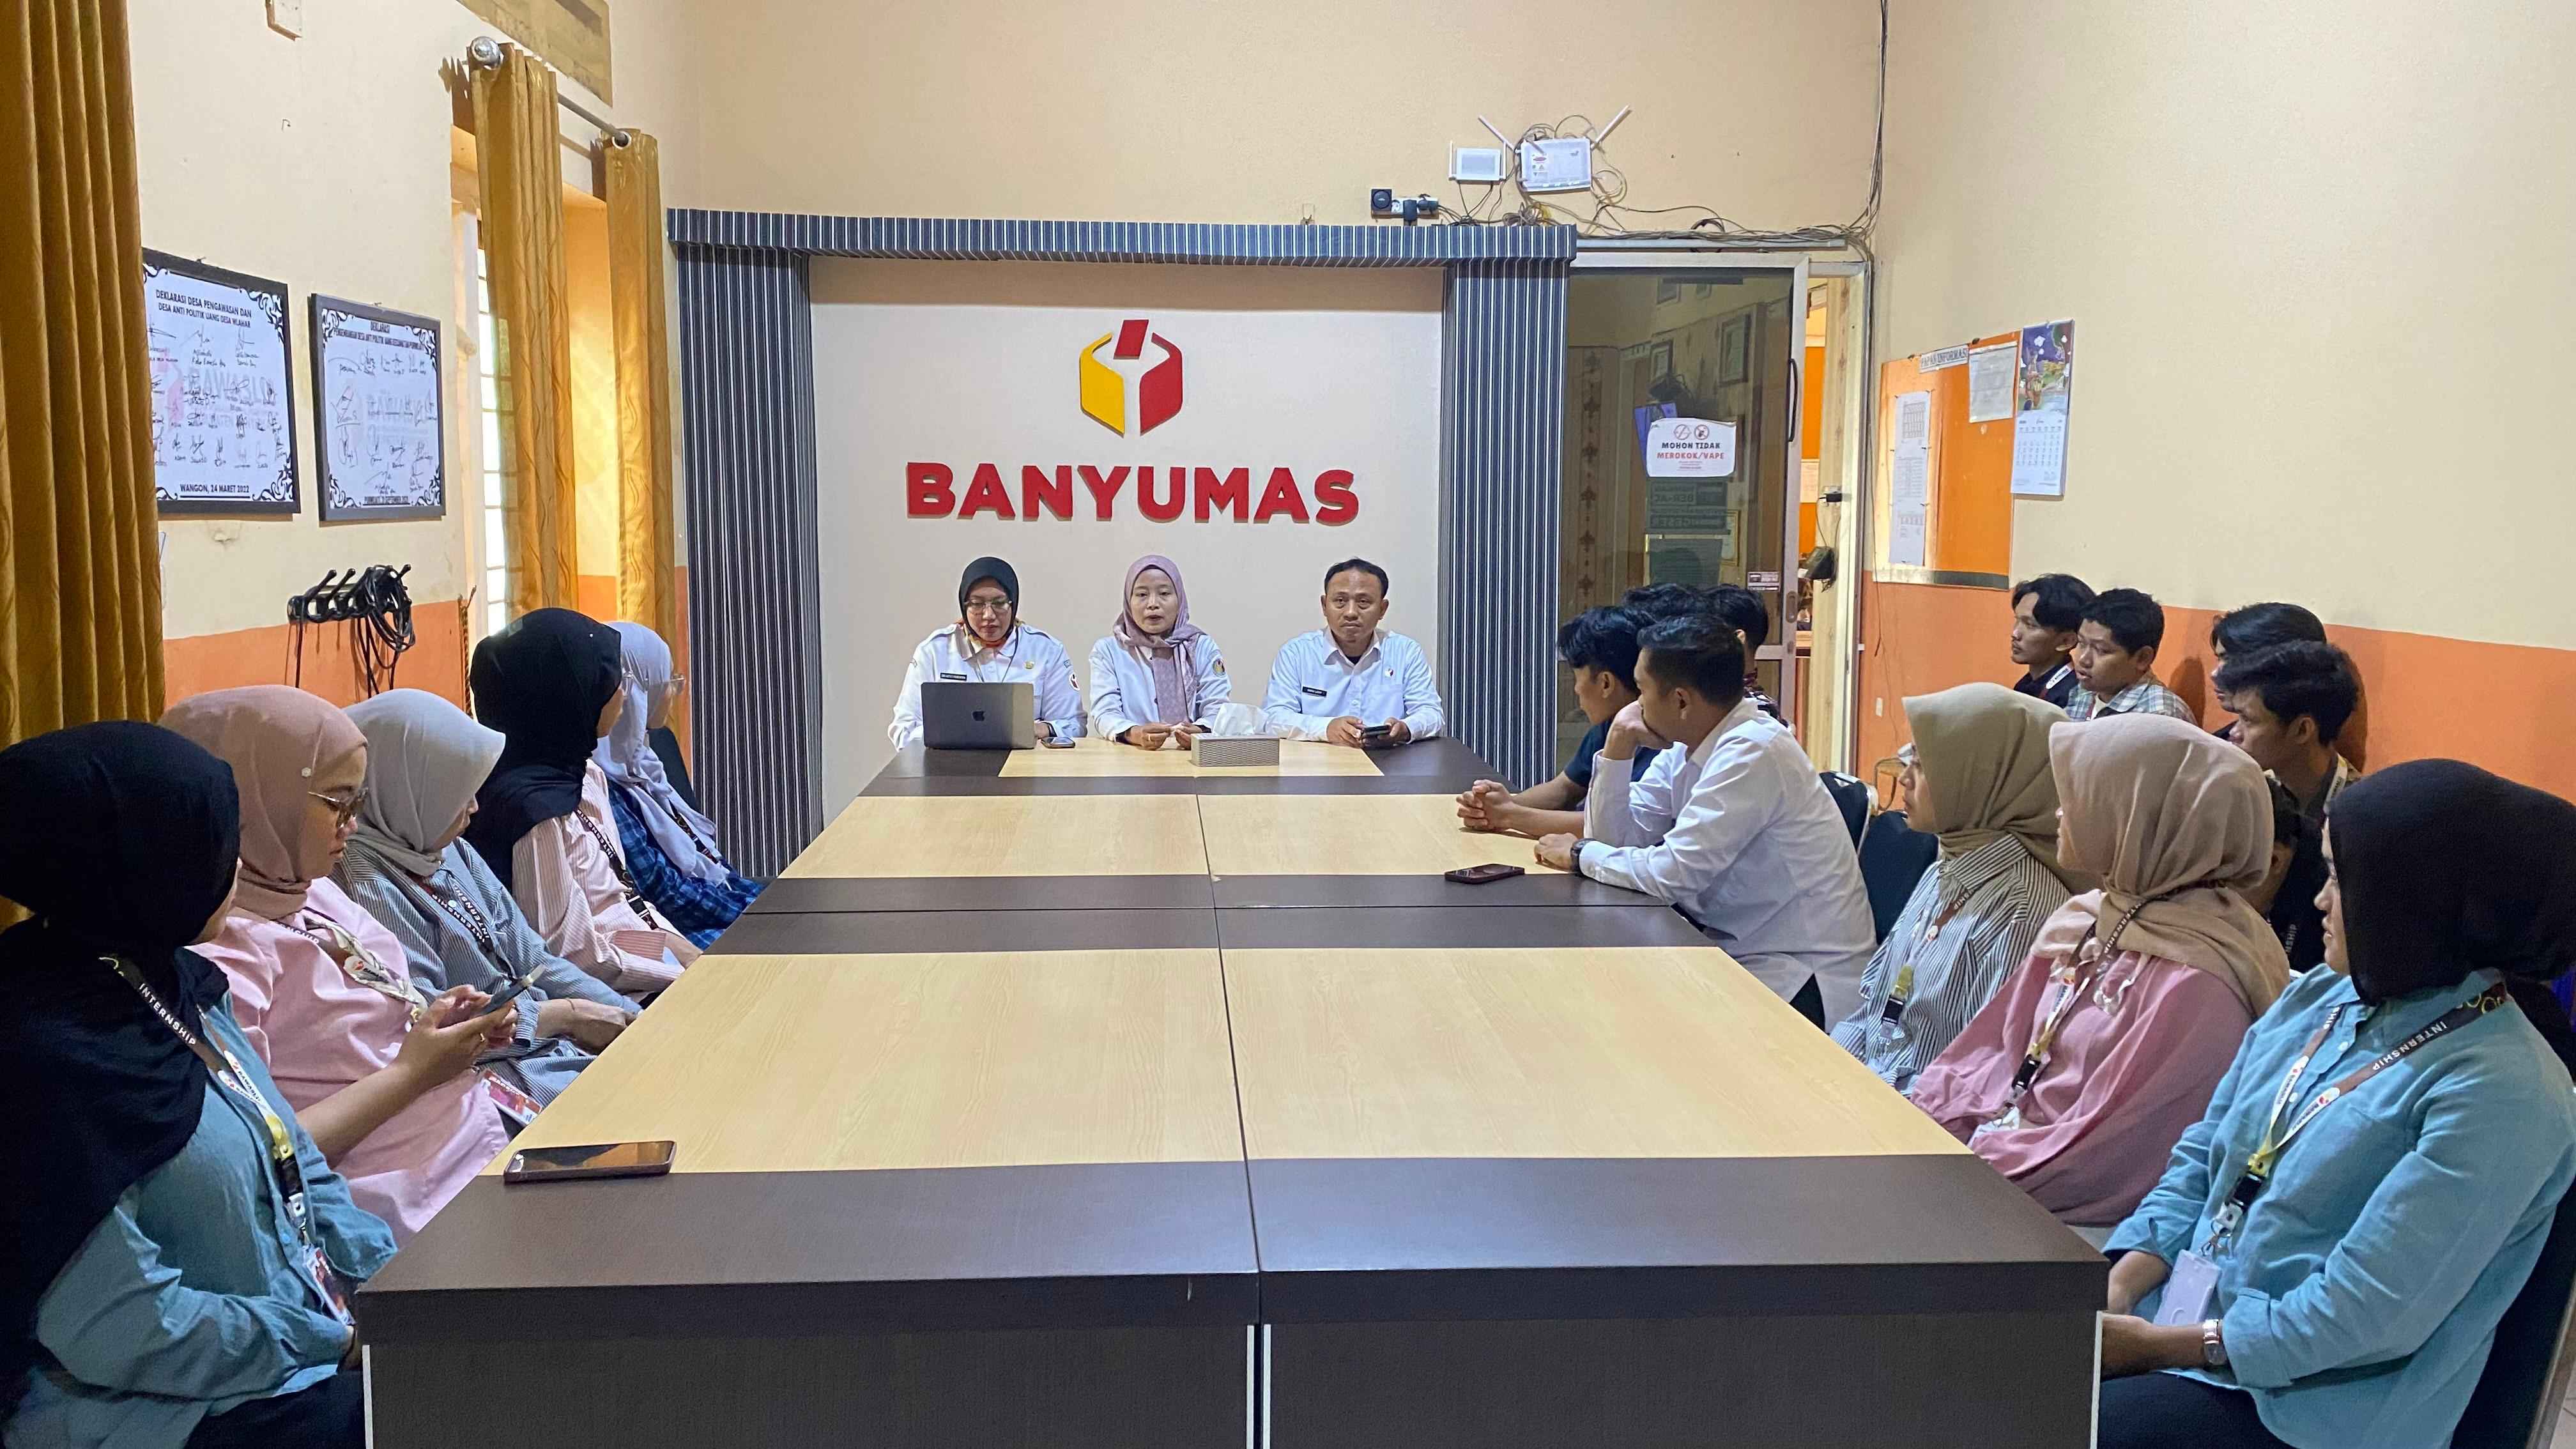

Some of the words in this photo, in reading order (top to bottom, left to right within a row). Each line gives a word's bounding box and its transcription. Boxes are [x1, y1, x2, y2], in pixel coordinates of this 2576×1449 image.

[156, 289, 186, 303] DEKLARASI
[188, 296, 202, 307] DESA
[204, 300, 239, 315] PENGAWASAN
[240, 308, 252, 319] DAN
[158, 302, 171, 312] DESA
[172, 305, 185, 314] ANTI
[186, 309, 204, 319] POLITIK
[205, 313, 220, 322] UANG
[220, 316, 231, 325] DESA
[180, 484, 210, 494] WANGON,
[211, 484, 218, 493] 24
[906, 461, 1360, 526] BANYUMAS
[578, 809, 613, 858] INTERNSHIP
[432, 894, 485, 942] INTERNSHIP
[139, 983, 196, 1045] INTERNSHIP
[2372, 1021, 2448, 1070] INTERNSHIP
